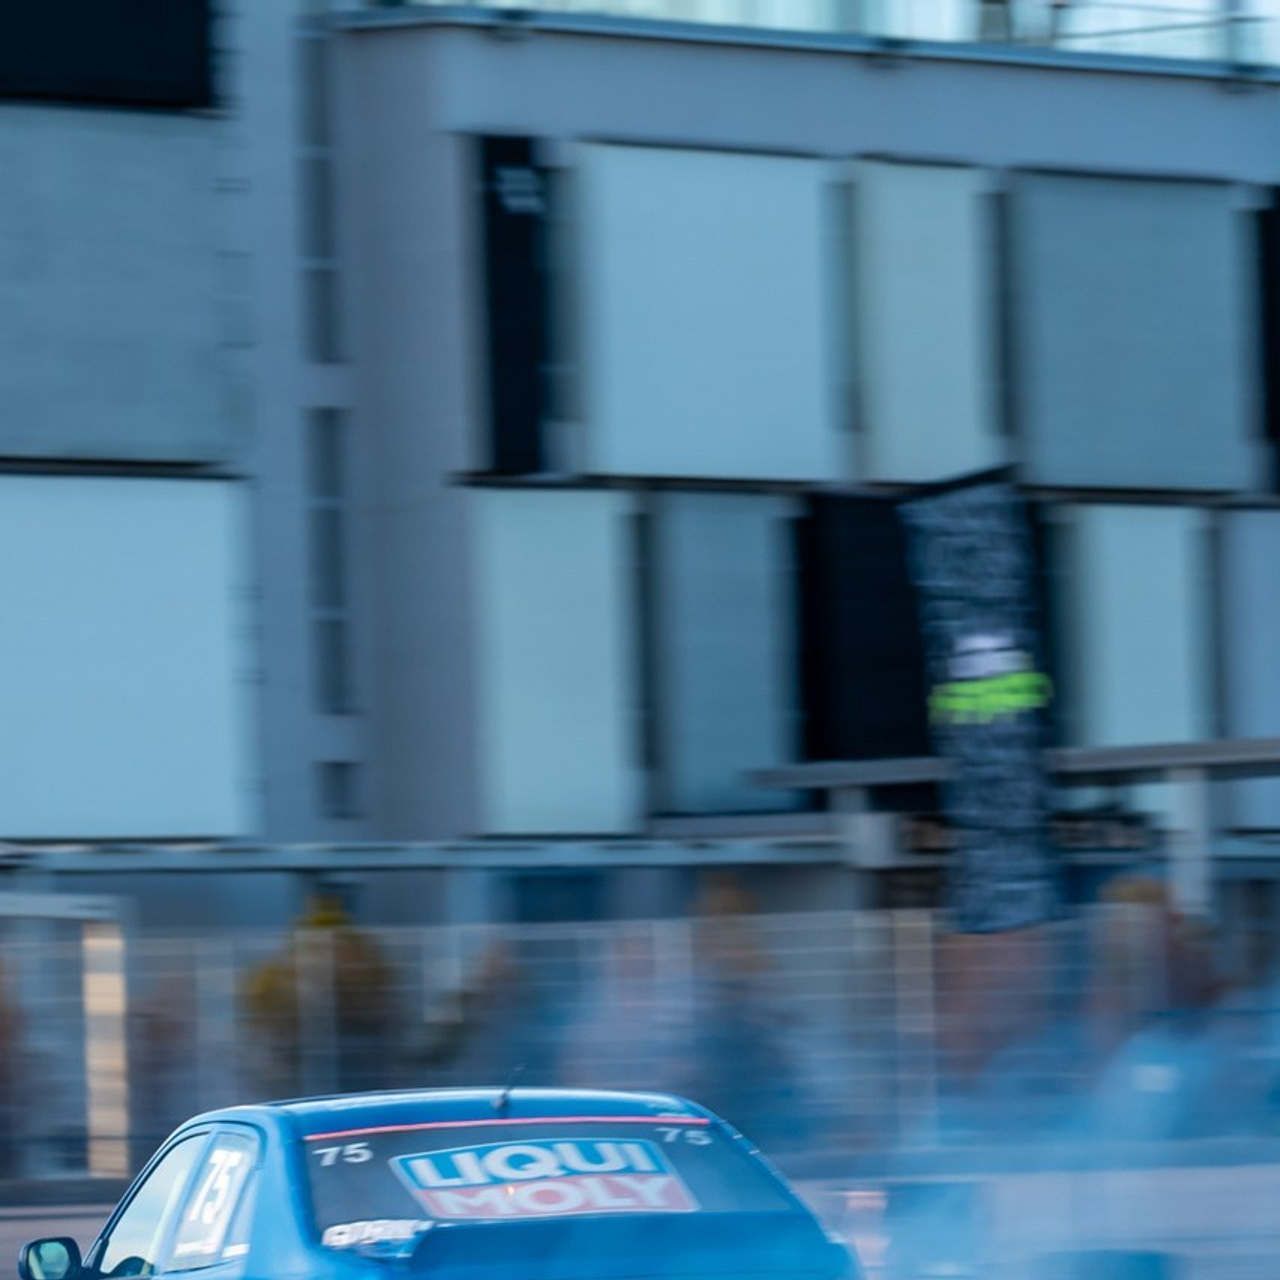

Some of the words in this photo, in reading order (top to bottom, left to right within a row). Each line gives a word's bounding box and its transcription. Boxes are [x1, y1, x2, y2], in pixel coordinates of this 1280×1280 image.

[312, 1142, 373, 1166] 75
[653, 1127, 714, 1145] 75
[408, 1142, 658, 1188] LIQUI
[188, 1149, 242, 1225] 75
[430, 1174, 674, 1216] MOLY
